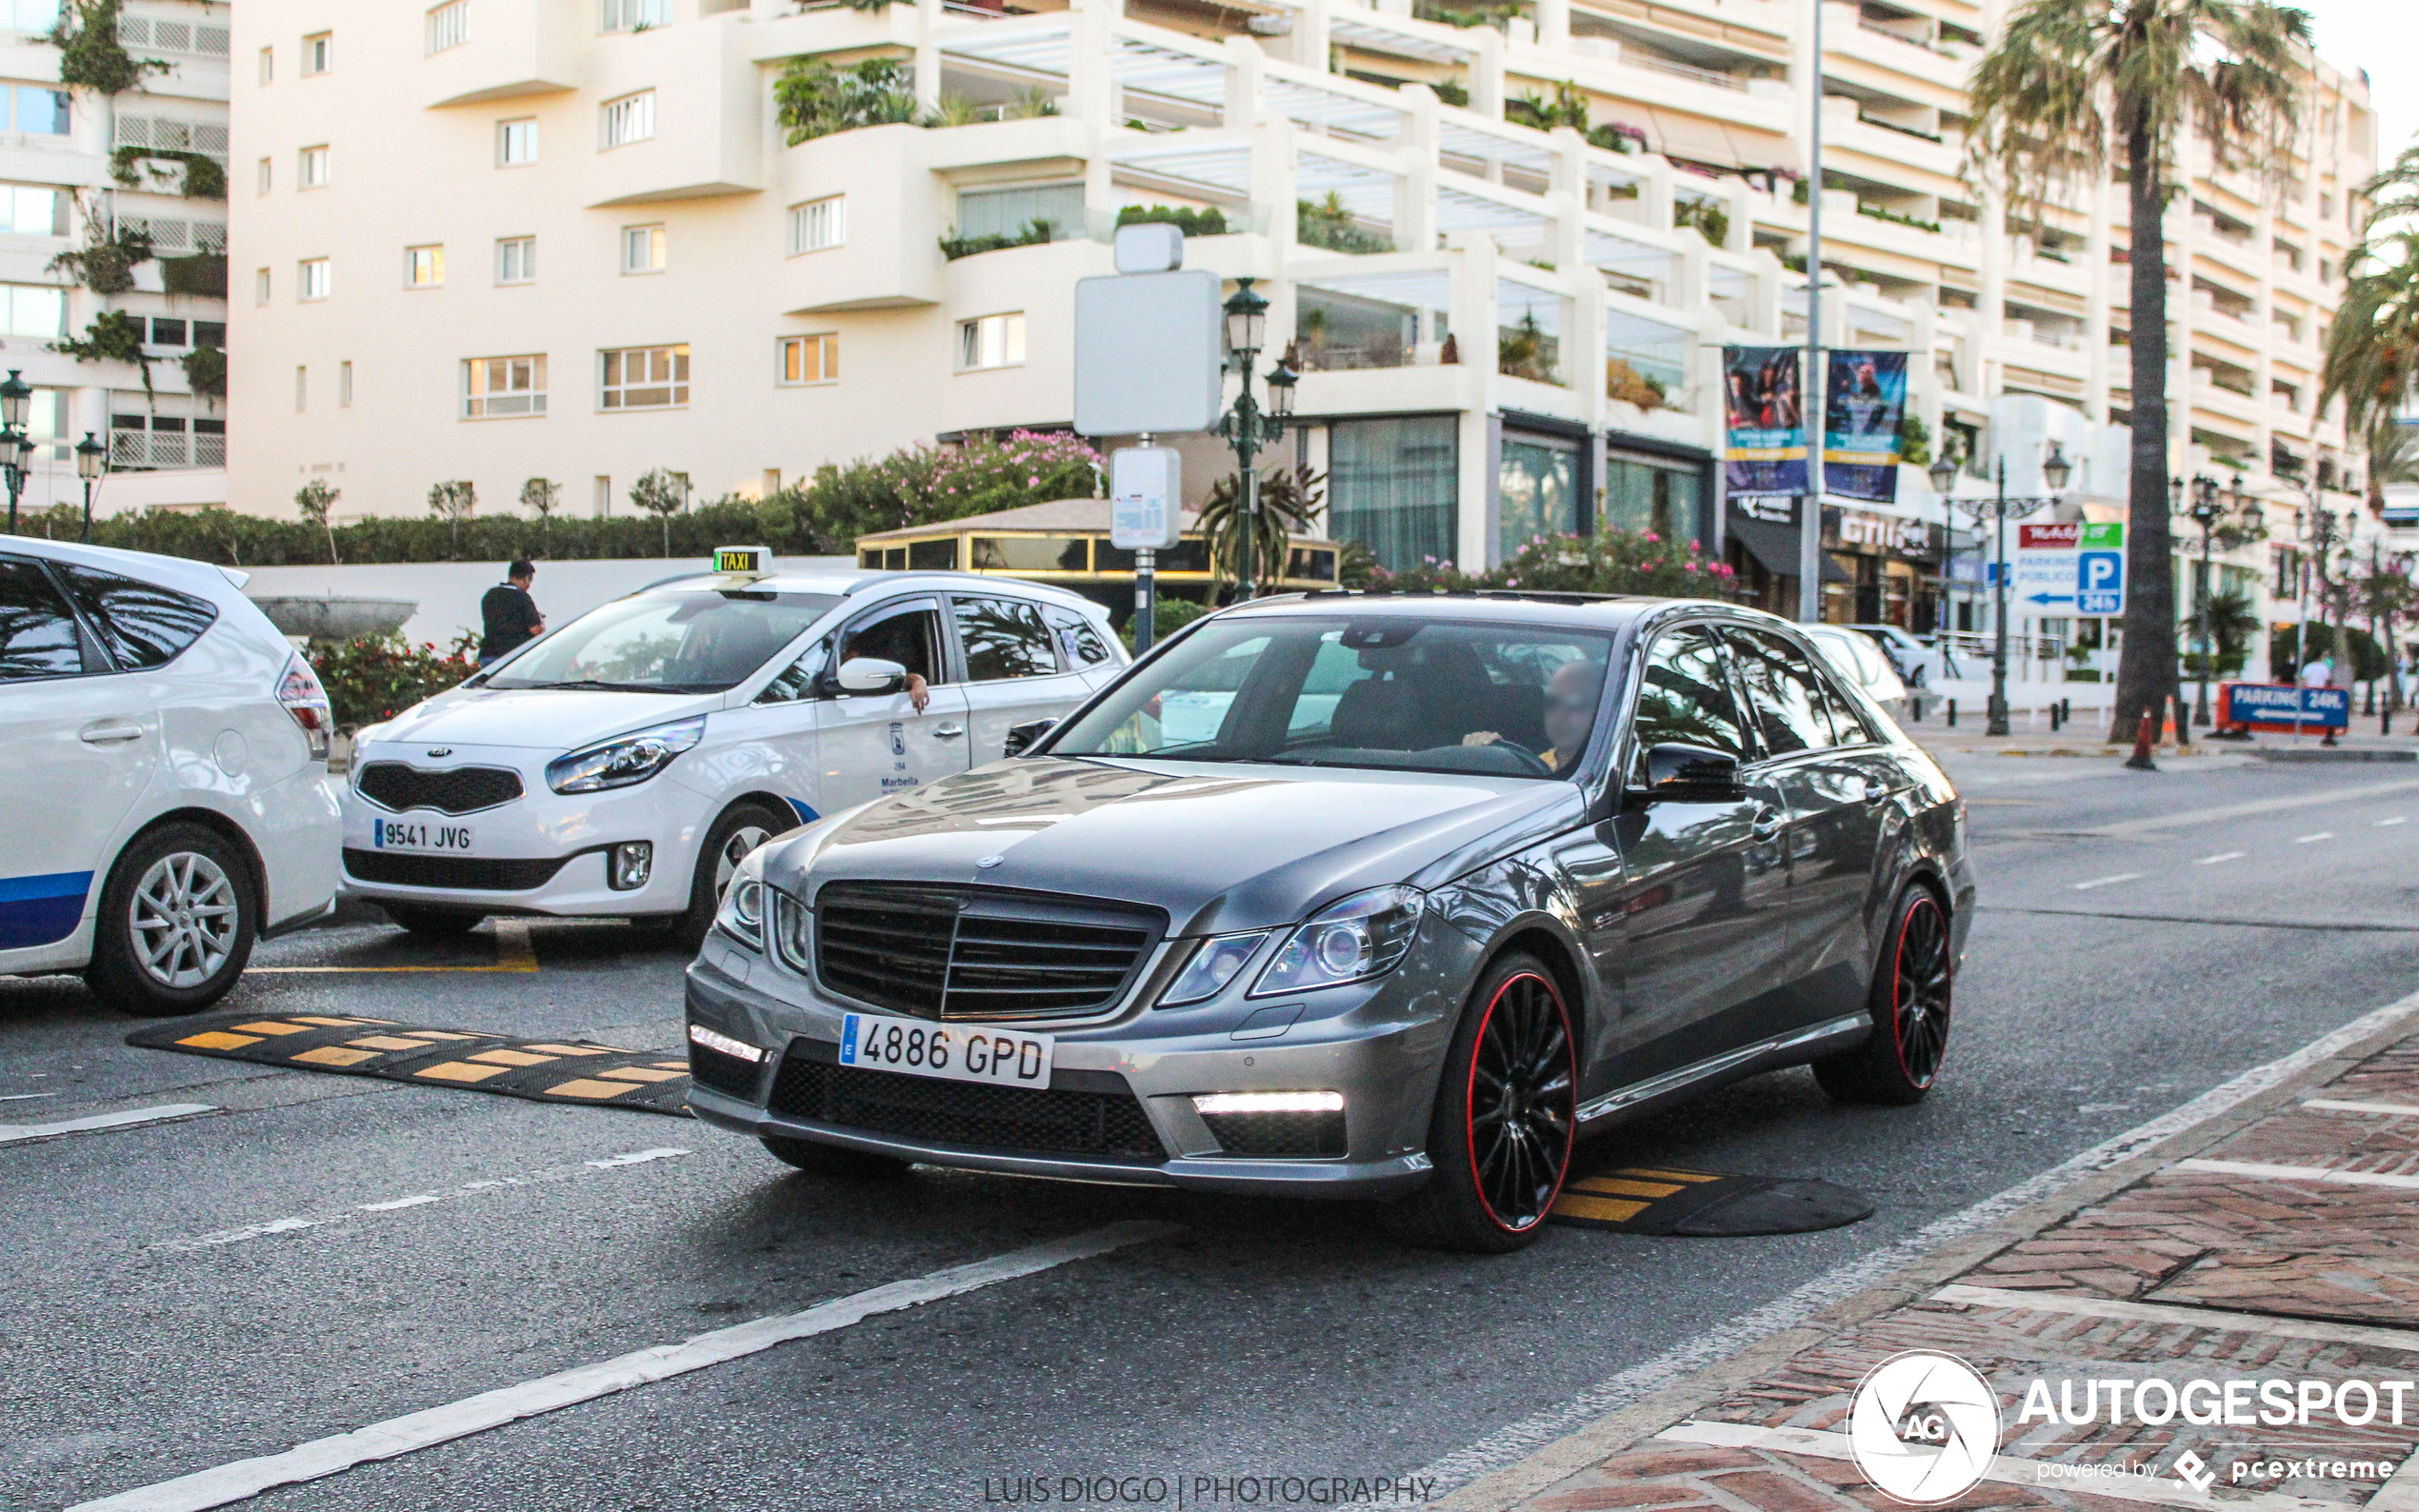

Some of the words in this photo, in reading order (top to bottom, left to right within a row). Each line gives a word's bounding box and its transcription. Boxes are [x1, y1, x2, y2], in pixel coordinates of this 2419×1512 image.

[722, 552, 749, 570] TAXI
[2088, 557, 2114, 589] P
[881, 776, 918, 787] Marbella
[386, 824, 427, 846] 9541
[434, 826, 470, 848] JVG
[863, 1024, 950, 1069] 4886
[965, 1034, 1043, 1080] GPD
